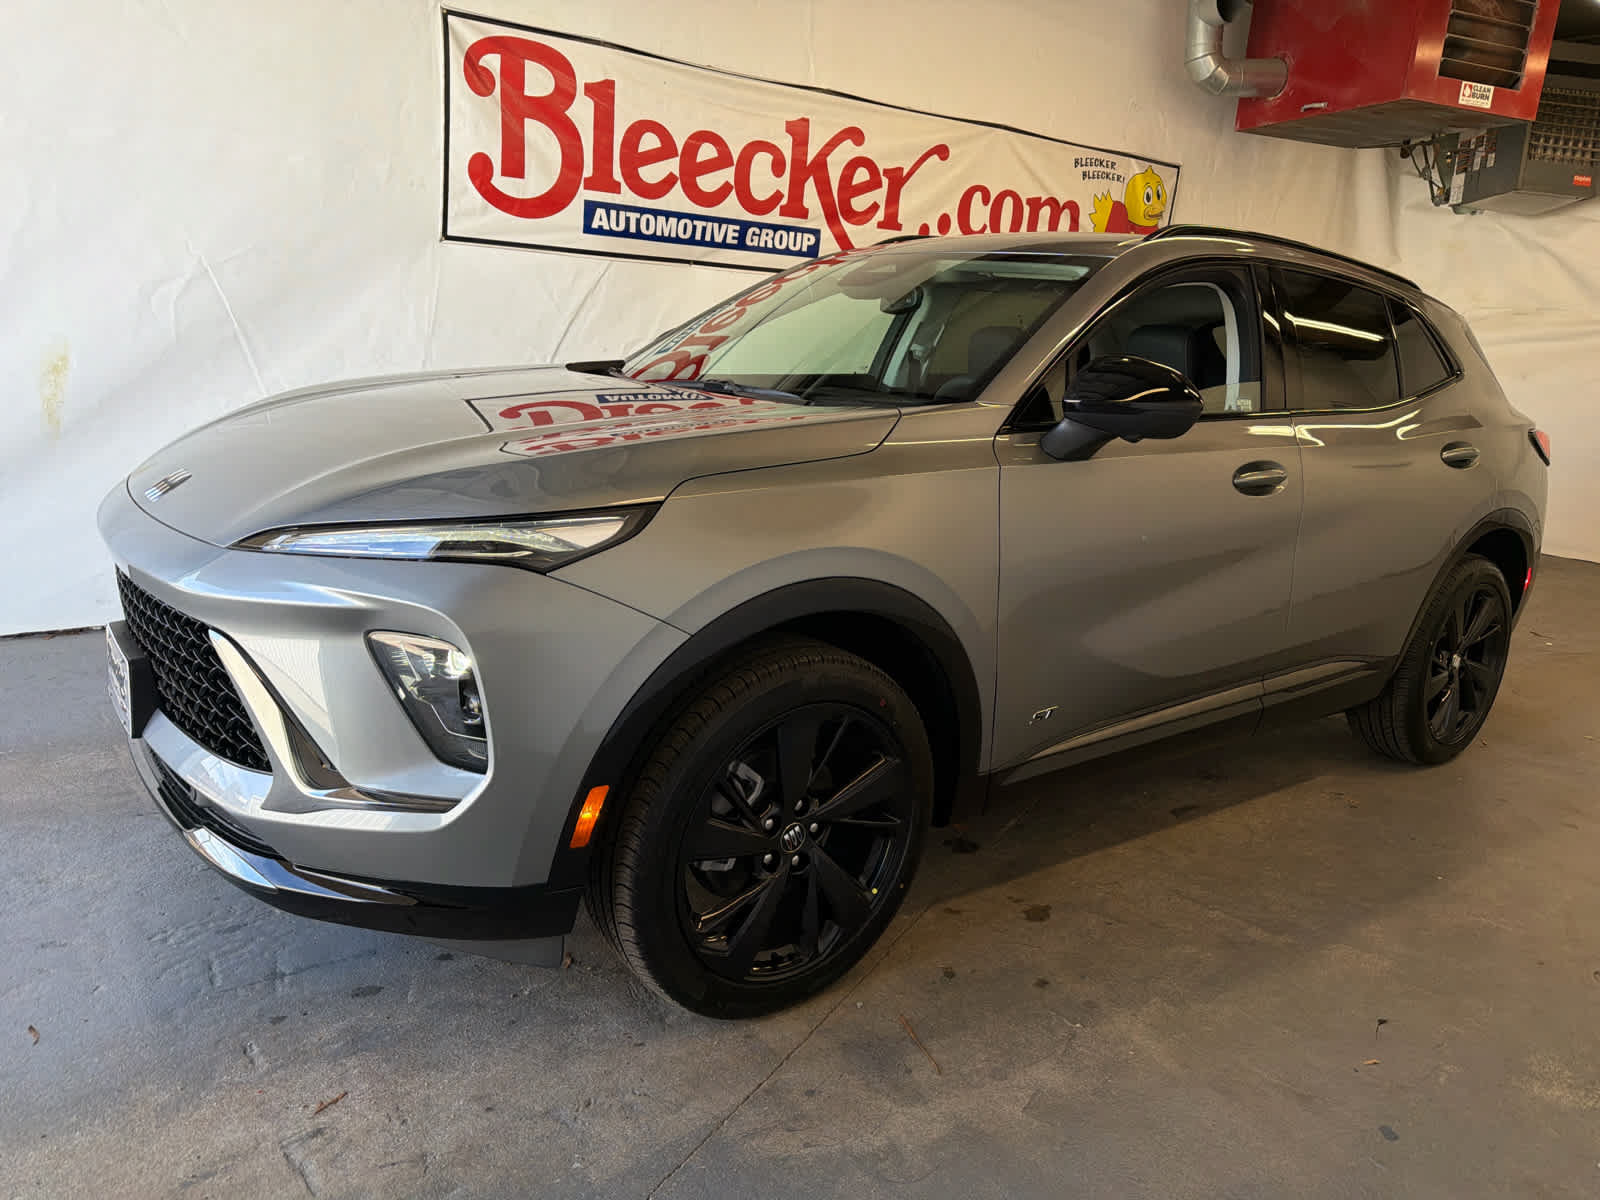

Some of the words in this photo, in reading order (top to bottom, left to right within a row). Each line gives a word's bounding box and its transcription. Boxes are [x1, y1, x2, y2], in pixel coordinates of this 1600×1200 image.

[1471, 92, 1490, 101] BURN
[1074, 157, 1117, 170] BLEECKER
[1082, 170, 1126, 184] BLEECKER!
[591, 208, 740, 245] AUTOMOTIVE
[745, 227, 816, 252] GROUP
